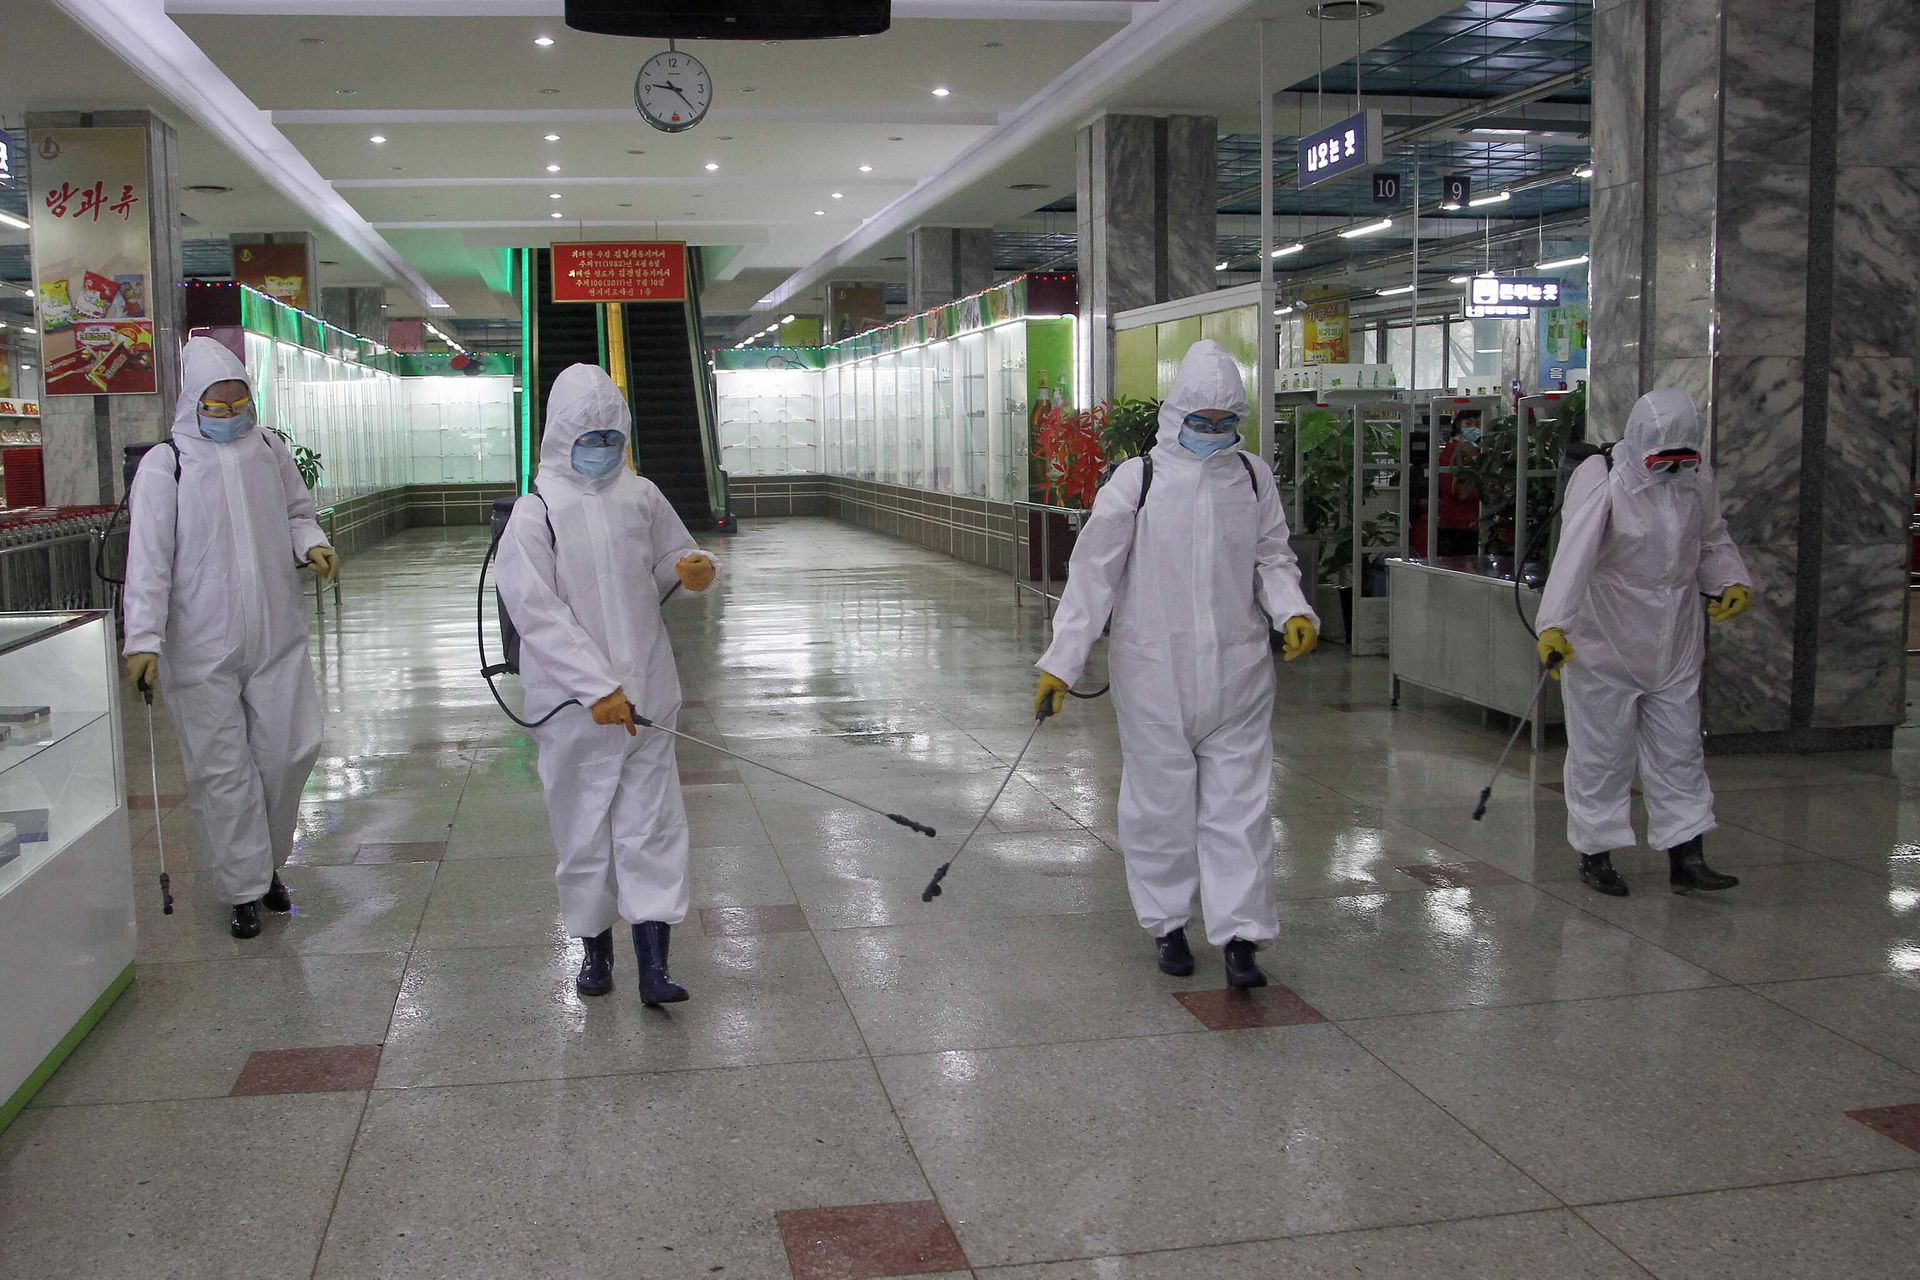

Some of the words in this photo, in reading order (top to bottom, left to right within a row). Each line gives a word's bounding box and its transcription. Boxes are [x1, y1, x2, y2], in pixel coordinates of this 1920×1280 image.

[668, 58, 677, 68] 12
[645, 84, 651, 94] 9
[698, 84, 704, 93] 3
[1307, 138, 1340, 172] 나오는
[1344, 129, 1356, 158] 곳
[1377, 179, 1396, 198] 10
[1451, 182, 1463, 200] 9
